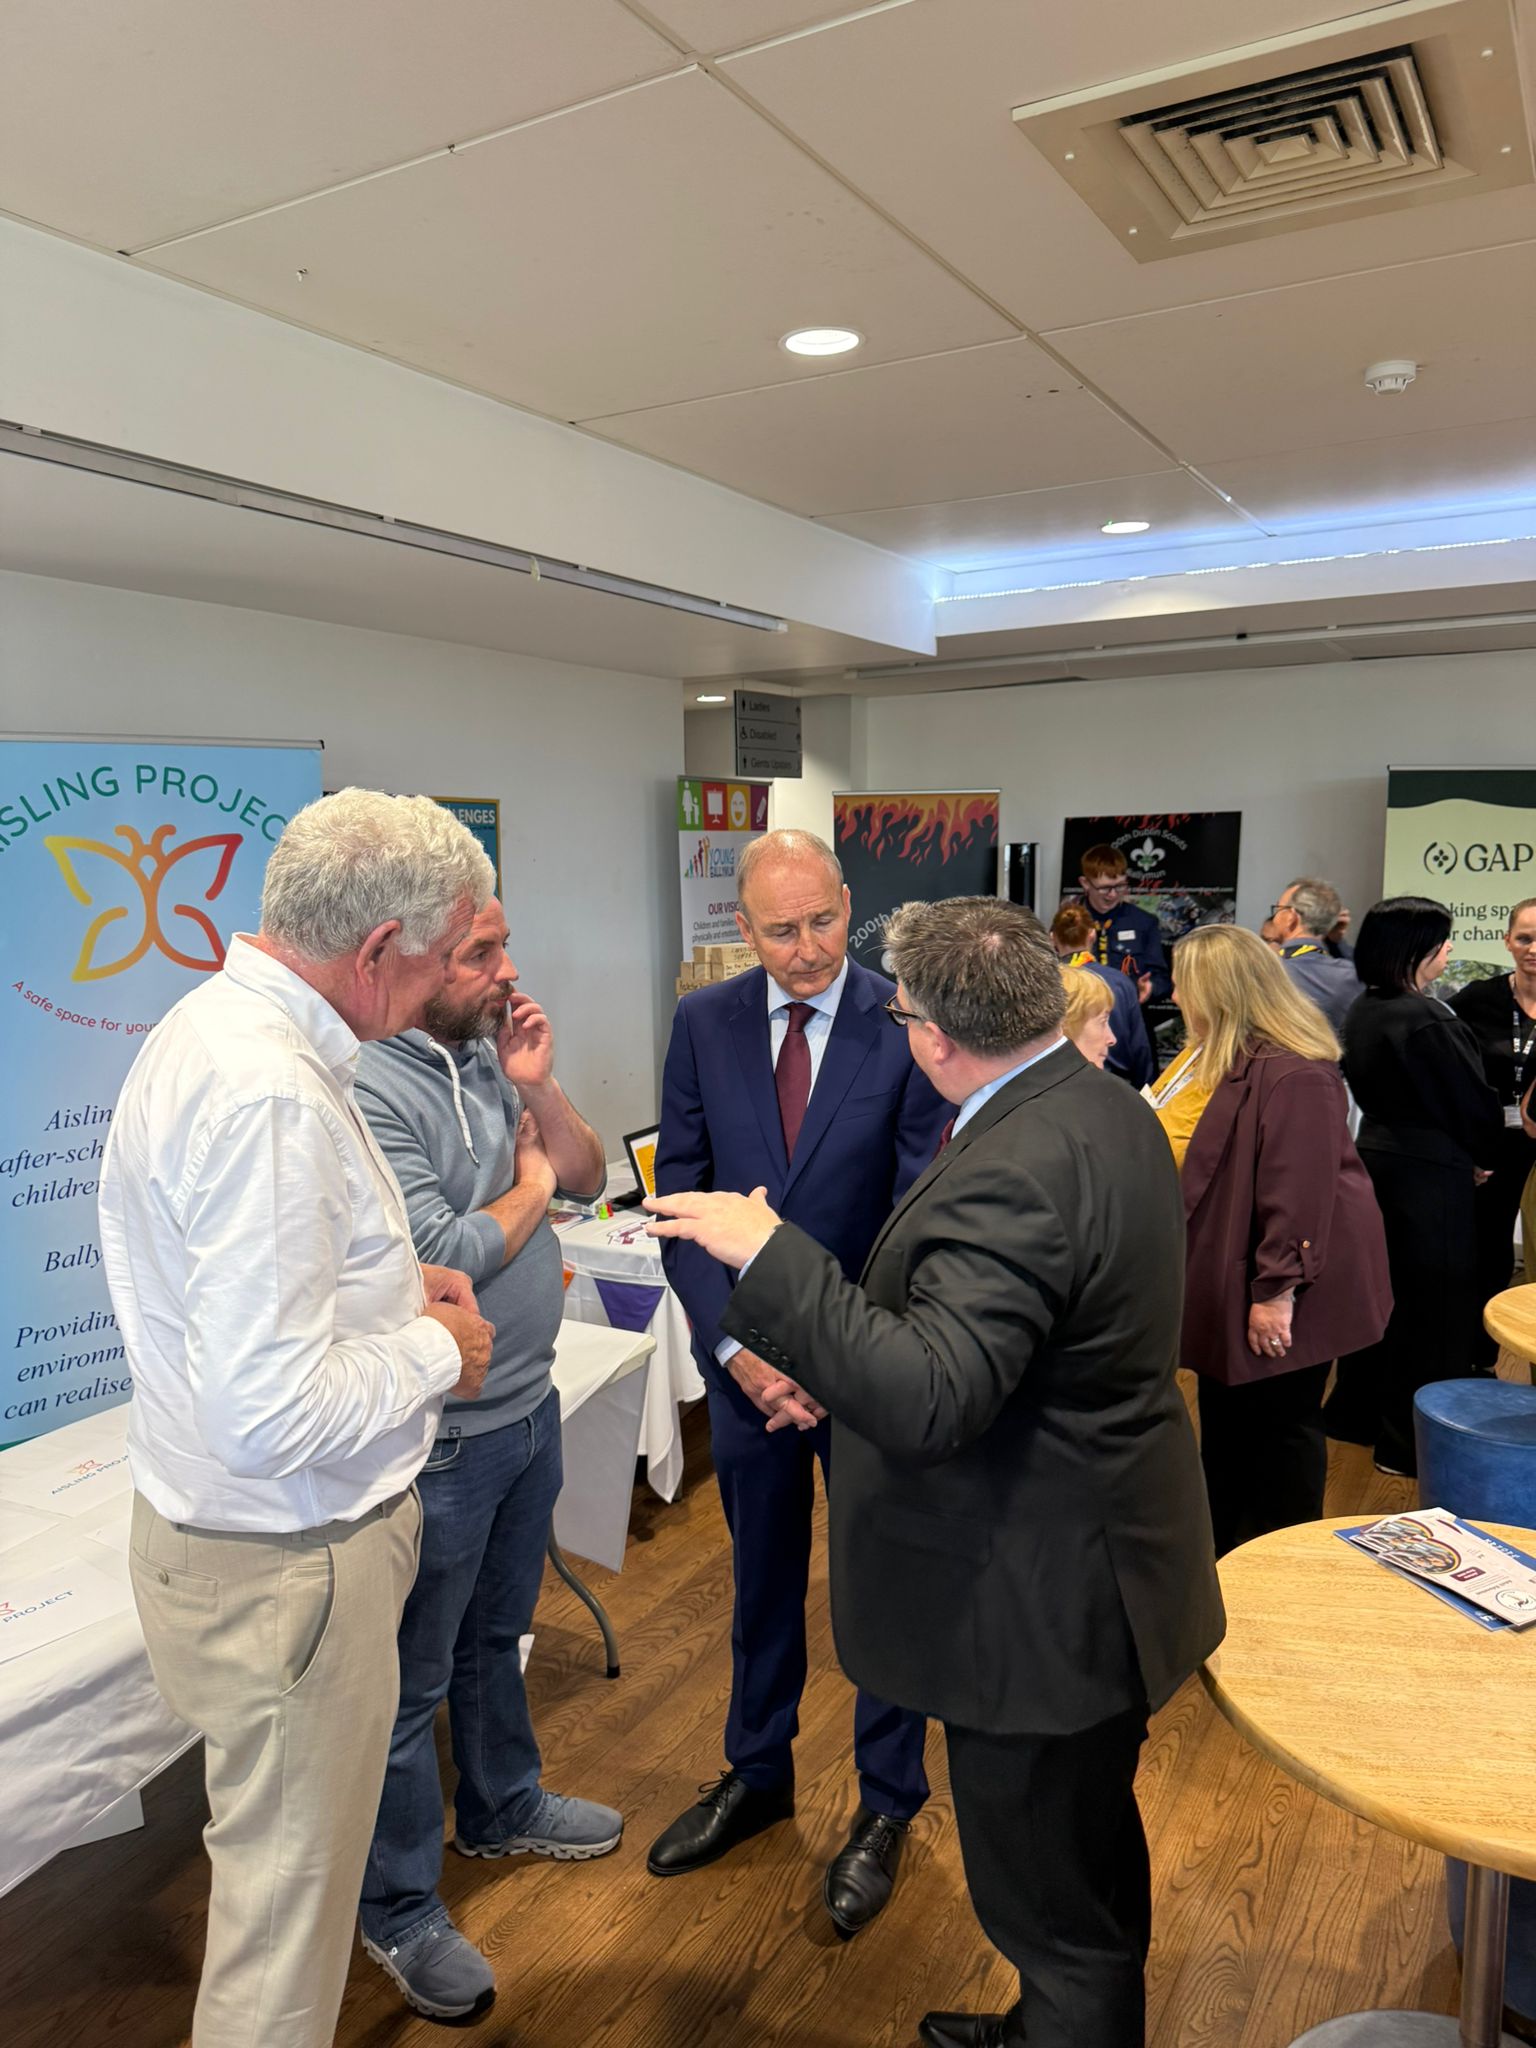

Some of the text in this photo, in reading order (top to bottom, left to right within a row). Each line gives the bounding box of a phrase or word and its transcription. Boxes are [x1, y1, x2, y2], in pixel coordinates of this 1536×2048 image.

[749, 701, 770, 713] Ladies
[750, 727, 777, 740] Disabled
[751, 757, 770, 769] Gents
[0, 766, 120, 851] SLING
[1161, 829, 1188, 850] Scouts
[709, 848, 735, 865] YOUNG
[1464, 843, 1534, 872] GAP
[708, 903, 722, 915] OUR
[1449, 902, 1513, 921] king sp
[11, 981, 159, 1035] A safe space for you
[43, 1105, 113, 1131] Aislin
[0, 1139, 104, 1178] after-sch
[43, 1244, 103, 1273] Bally
[14, 1311, 121, 1348] Providin
[4, 1377, 133, 1420] can realise
[52, 1472, 96, 1495] AISLING
[3, 1590, 73, 1623] PROJECT
